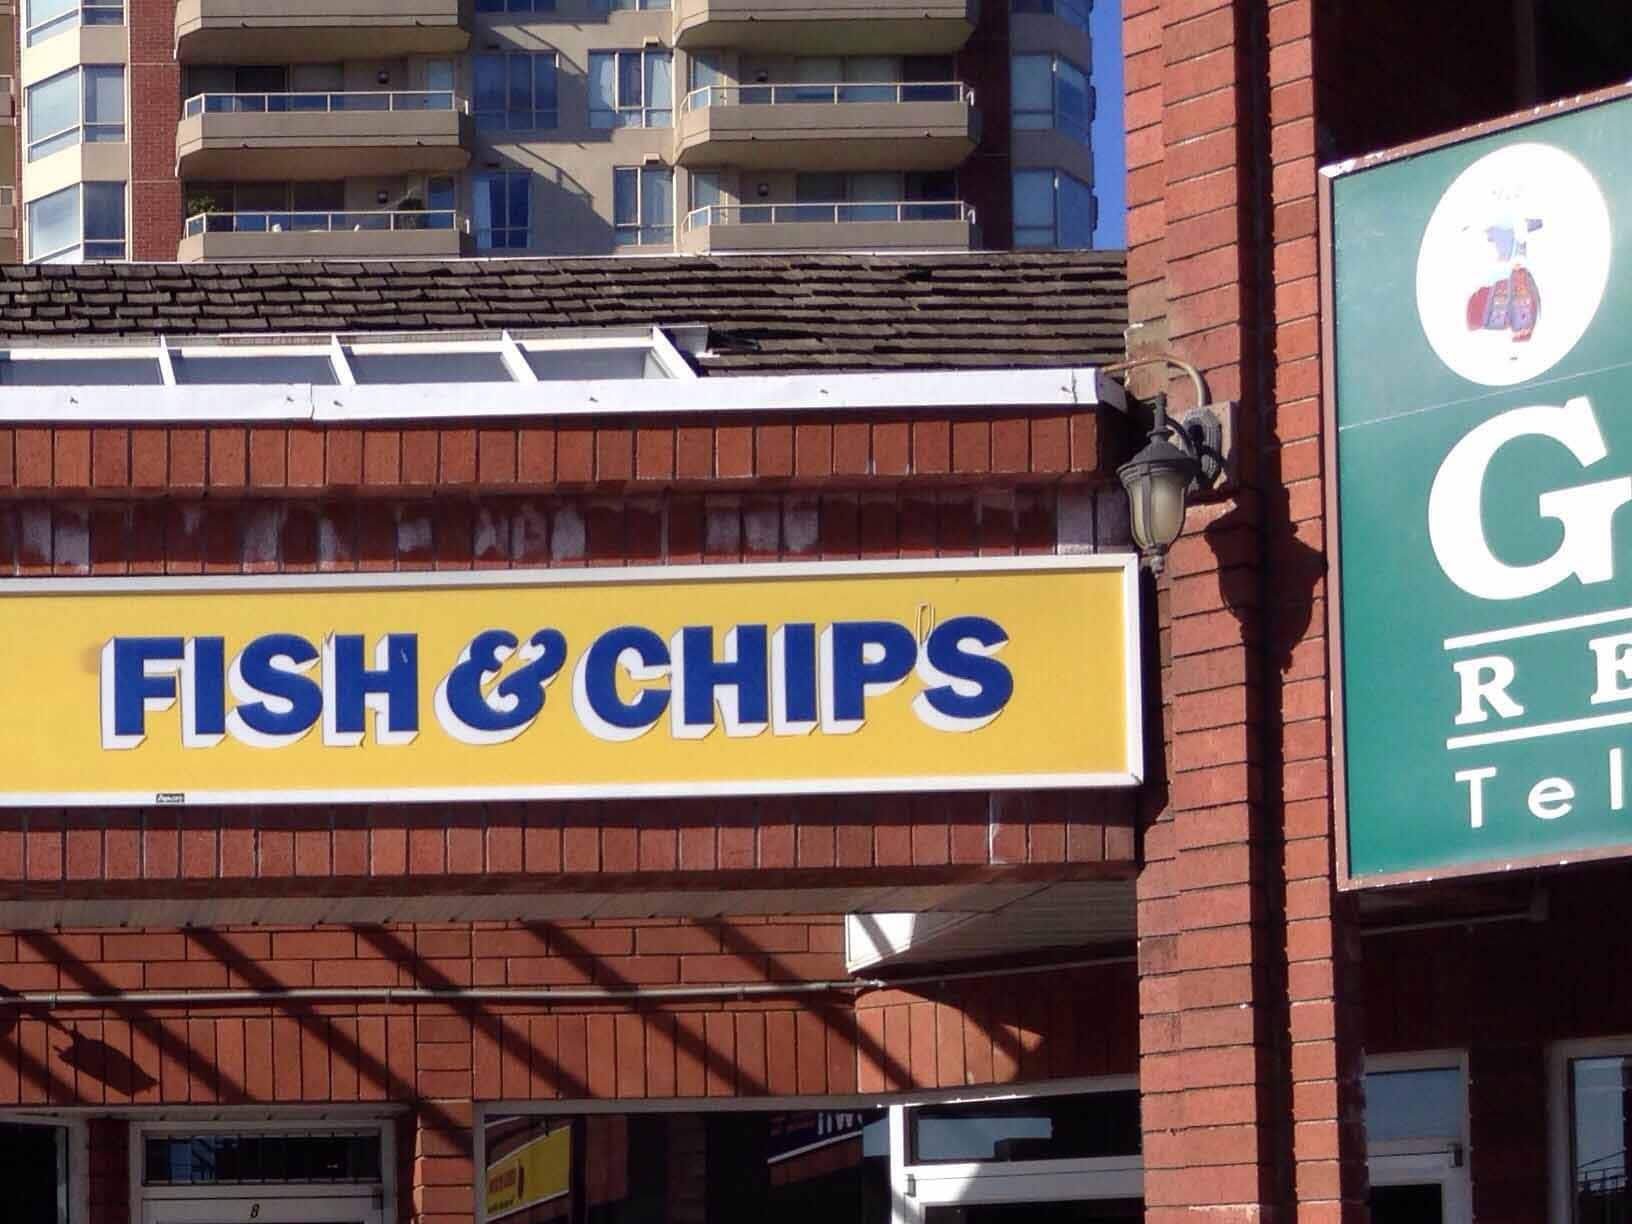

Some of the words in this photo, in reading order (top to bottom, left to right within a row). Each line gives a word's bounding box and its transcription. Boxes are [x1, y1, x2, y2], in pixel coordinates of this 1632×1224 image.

[100, 632, 420, 749] FISH
[436, 628, 568, 745] &
[573, 616, 1014, 742] CHIPS
